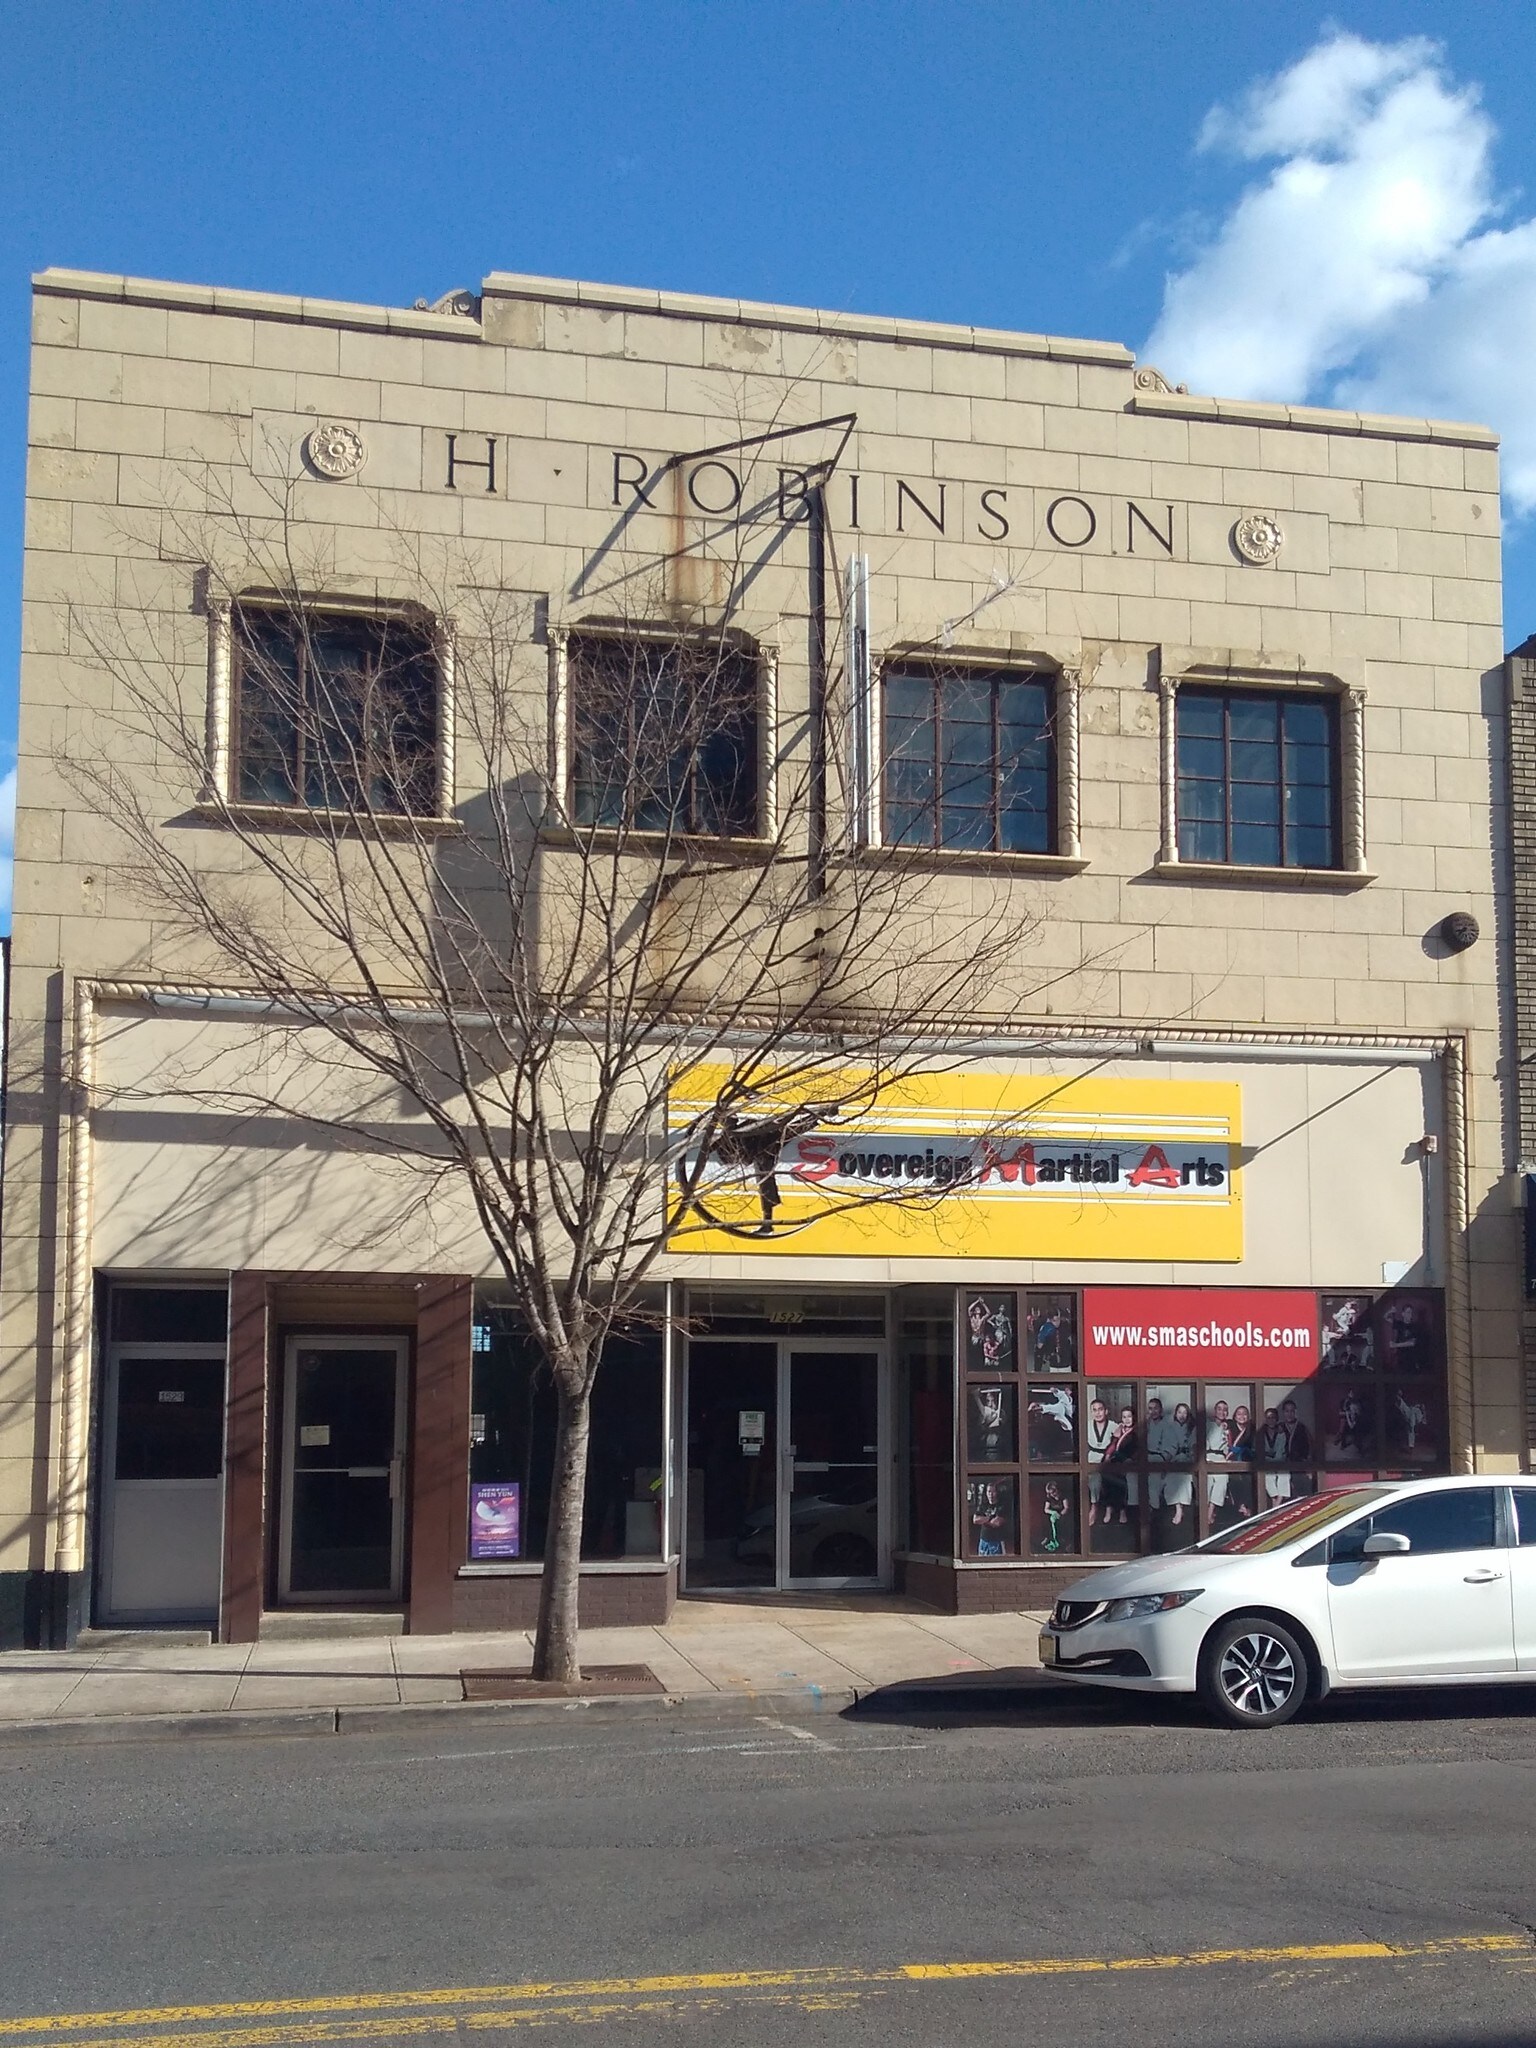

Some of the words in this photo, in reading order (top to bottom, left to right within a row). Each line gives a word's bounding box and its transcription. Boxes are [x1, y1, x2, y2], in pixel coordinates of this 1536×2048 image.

[443, 433, 498, 494] H
[610, 450, 1176, 558] ROBINSON
[791, 1137, 973, 1185] Sovereign
[978, 1138, 1120, 1186] Martial
[1124, 1143, 1226, 1189] Arts
[772, 1312, 804, 1322] 1527
[1092, 1320, 1311, 1349] www.smaschools.com
